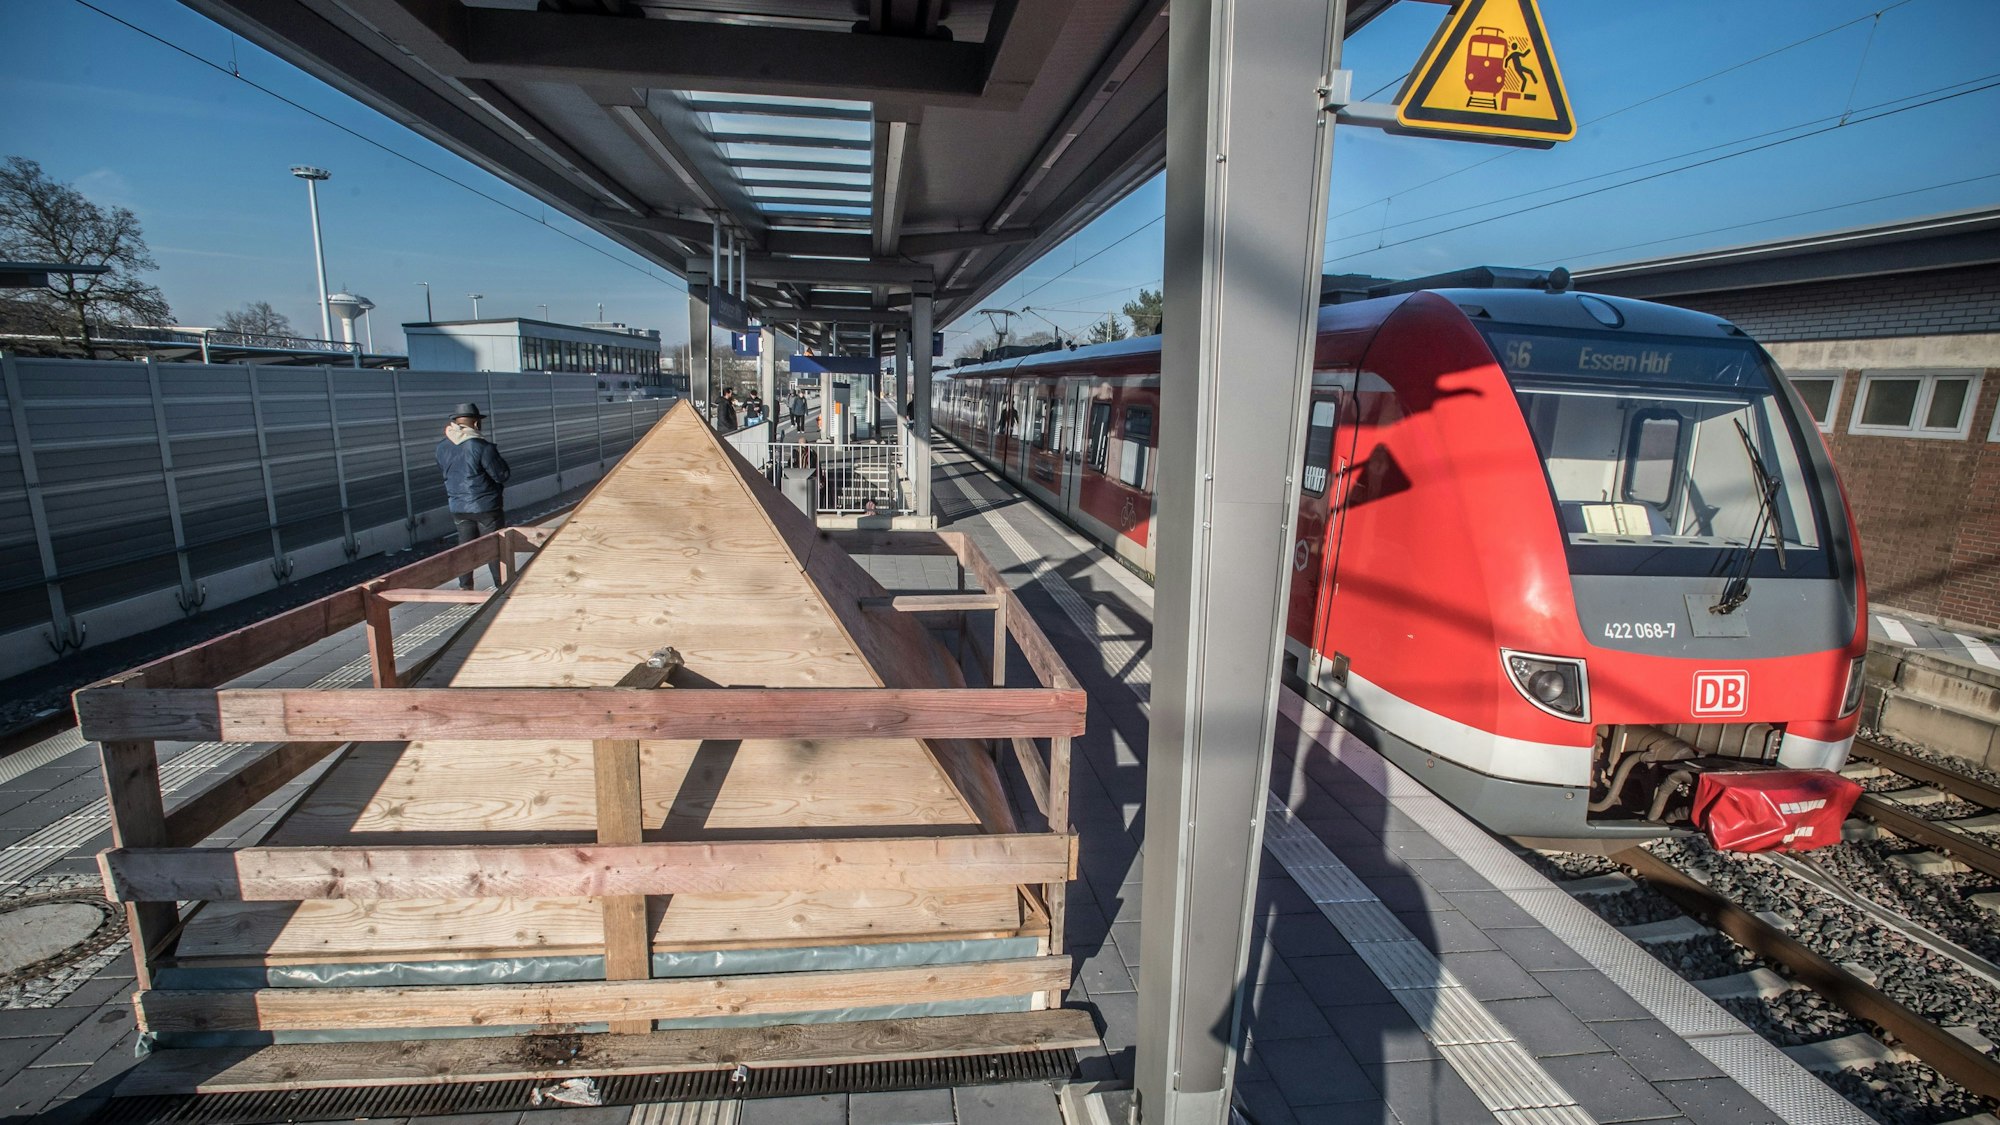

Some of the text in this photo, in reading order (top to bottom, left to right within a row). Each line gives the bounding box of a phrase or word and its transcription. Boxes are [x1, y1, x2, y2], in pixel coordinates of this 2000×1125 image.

[739, 335, 747, 351] 1
[1505, 340, 1533, 369] S6
[1578, 346, 1673, 375] Essen Hbf
[1604, 622, 1676, 639] 422 068-7
[1699, 678, 1742, 709] DB
